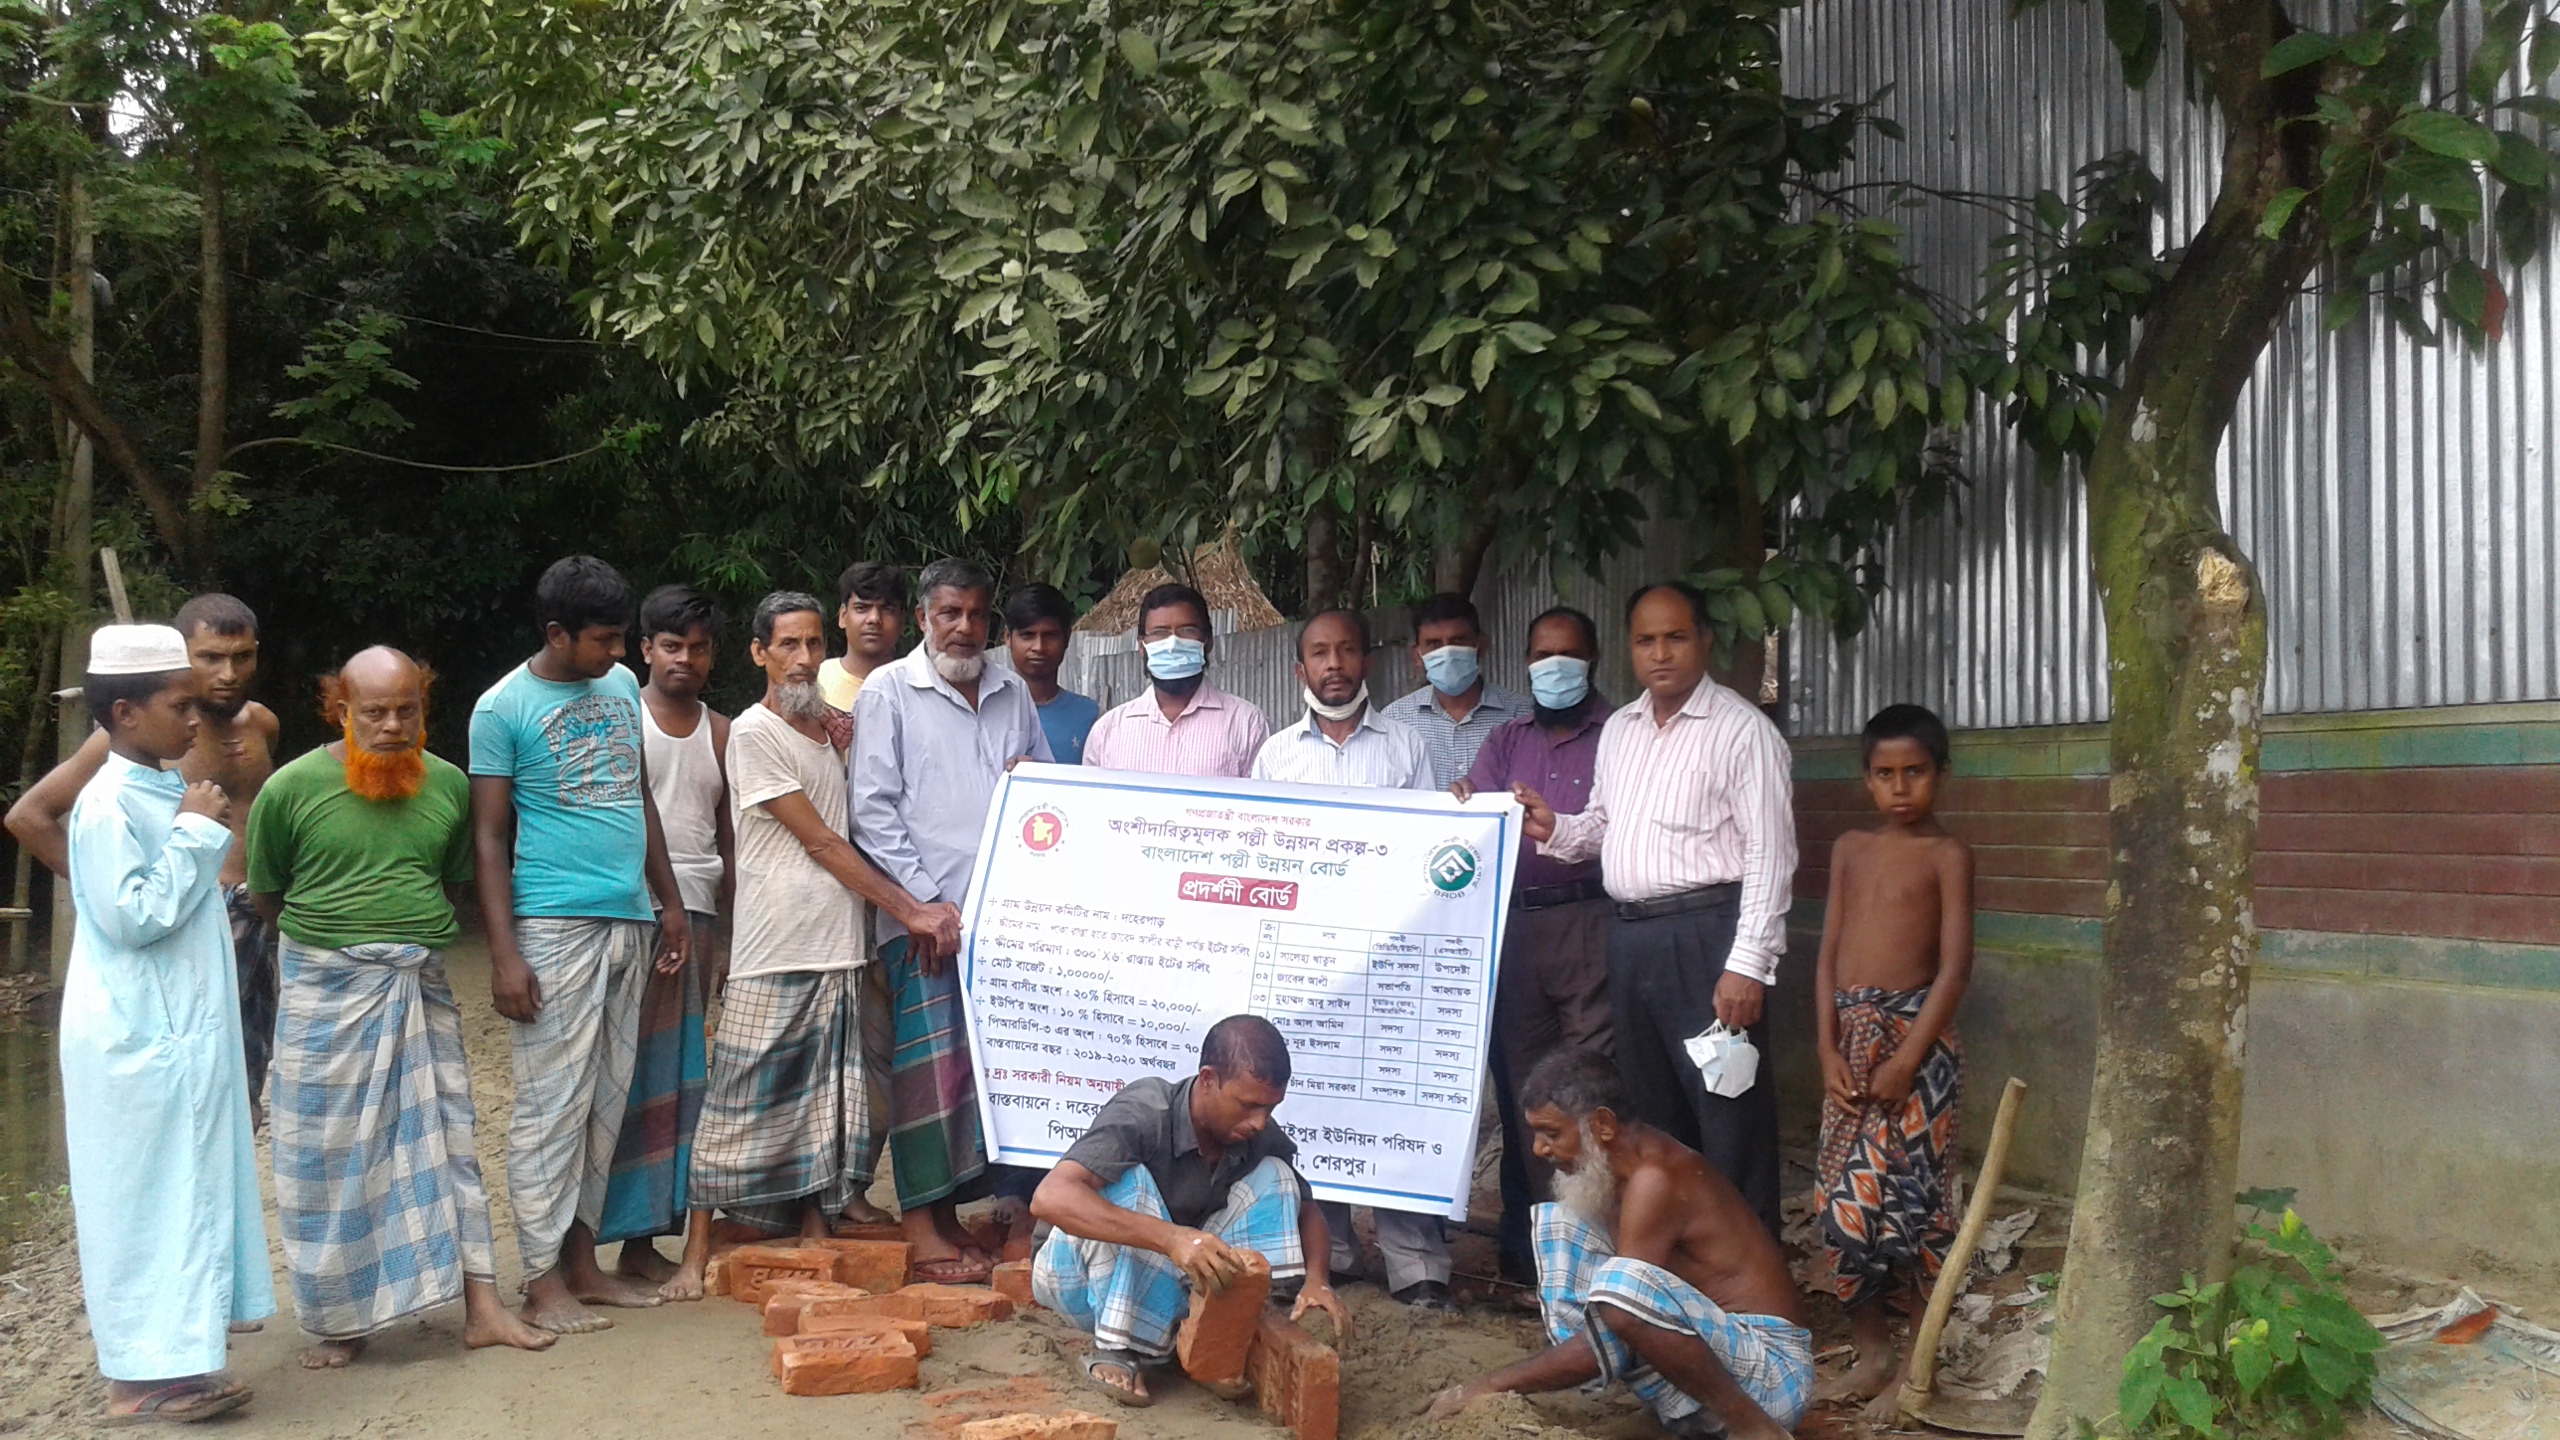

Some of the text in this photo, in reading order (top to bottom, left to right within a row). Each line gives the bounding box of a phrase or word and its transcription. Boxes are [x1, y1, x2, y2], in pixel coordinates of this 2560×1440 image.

[1238, 811, 1278, 824] বাংলাদেশ
[1281, 815, 1312, 828] সরকার
[1109, 816, 1388, 856] অংশীদারিত্বমূলক পল্লী উন্নয়ন প্রকল্প-৩
[1142, 844, 1349, 877] বাংলাদেশ পল্লী উন্নয়ন বোর্ড
[1182, 876, 1292, 907] প্রদর্শনী বোর্ড
[1001, 898, 1020, 910] গ্রাম
[1024, 898, 1051, 913] উন্নয়ন
[1055, 903, 1090, 918] কমিটির
[1093, 909, 1110, 920] নাম
[1258, 950, 1271, 960] ০১
[991, 956, 1013, 969] মোট
[1015, 959, 1046, 973] বাজেট
[1255, 971, 1269, 981] ০২
[990, 977, 1008, 990] গ্রাম
[1041, 984, 1062, 997] অংশ
[1073, 989, 1100, 1003] ২০%
[1103, 990, 1135, 1006] হিসাবে
[1151, 999, 1202, 1016] ২০,০০০/-
[1028, 1001, 1049, 1015] অংশ
[1060, 1007, 1074, 1018] ১০
[1078, 1008, 1089, 1021] %
[1092, 1009, 1124, 1025] হিসাবে
[1140, 1017, 1190, 1035] ১০,০০০/-
[1437, 1006, 1463, 1018] সদস্য
[988, 1013, 1051, 1033] পিআরডিপি-৩
[1055, 1025, 1069, 1037] এর
[1072, 1028, 1094, 1041] অংশ
[1106, 1032, 1132, 1046] ৭০%
[1135, 1034, 1168, 1051] হিসাবে
[1380, 1023, 1404, 1035] সদস্য
[1436, 1028, 1462, 1040] সদস্য
[1309, 1036, 1341, 1051] ইসলাম
[1379, 1044, 1403, 1056] সদস্য
[986, 1036, 1039, 1052] বাস্তবায়নের
[1042, 1043, 1062, 1056] বছর
[1139, 1055, 1177, 1071] অর্থবছর
[1435, 1049, 1461, 1062] সদস্য
[1012, 1068, 1051, 1084] সরকারী
[1055, 1071, 1082, 1087] নিয়ম
[1378, 1065, 1402, 1077] সদস্য
[1433, 1070, 1459, 1083] সদস্য
[1328, 1082, 1356, 1093] সরকার
[1421, 1090, 1443, 1102] সদস্য
[989, 1092, 1051, 1111] বাস্তবায়নে
[1322, 1124, 1377, 1147] ইউনিয়ন
[1382, 1133, 1427, 1155] পরিষদ
[1431, 1142, 1443, 1156] ও
[1313, 1153, 1367, 1178] শেরপুর
